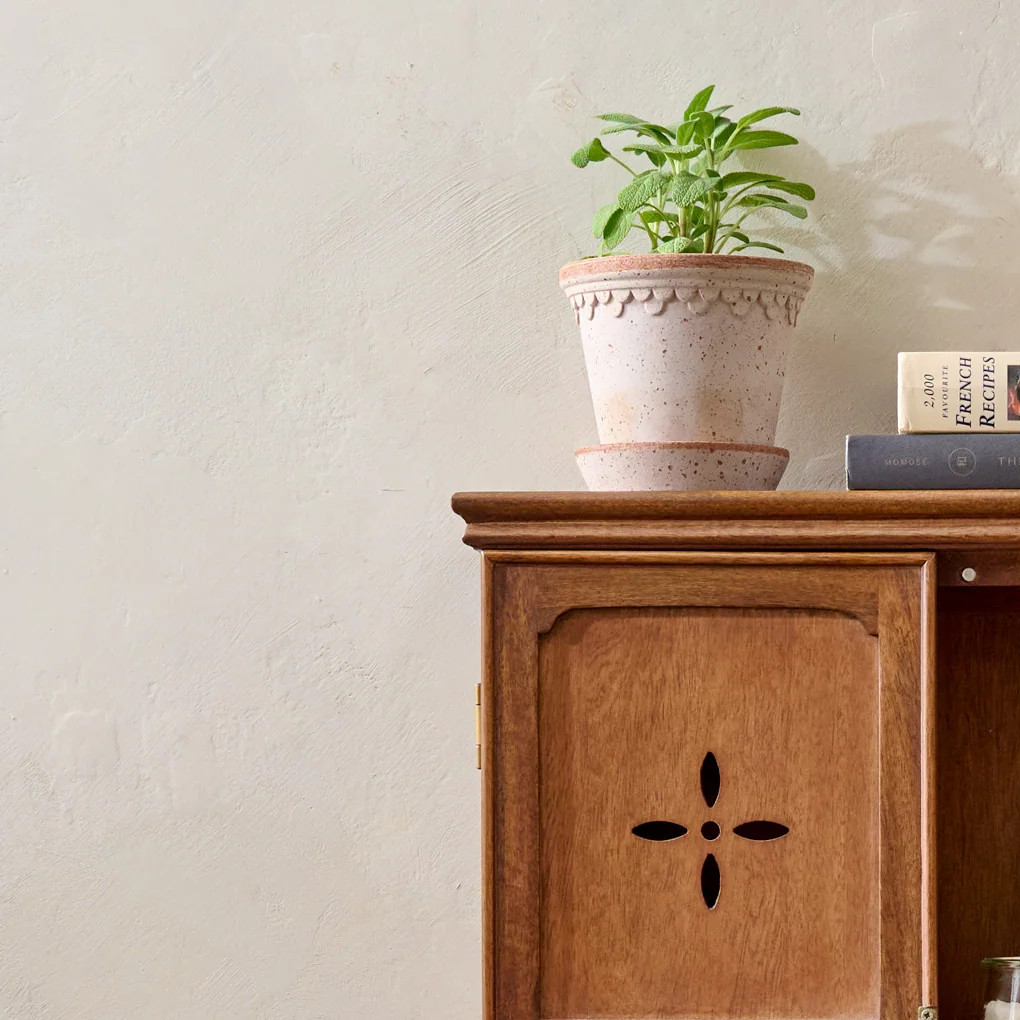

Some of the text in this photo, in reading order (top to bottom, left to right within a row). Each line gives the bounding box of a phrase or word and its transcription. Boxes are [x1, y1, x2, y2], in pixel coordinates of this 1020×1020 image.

[924, 374, 935, 408] 2,000
[955, 357, 972, 428] FRENCH
[979, 356, 996, 428] RECIPES
